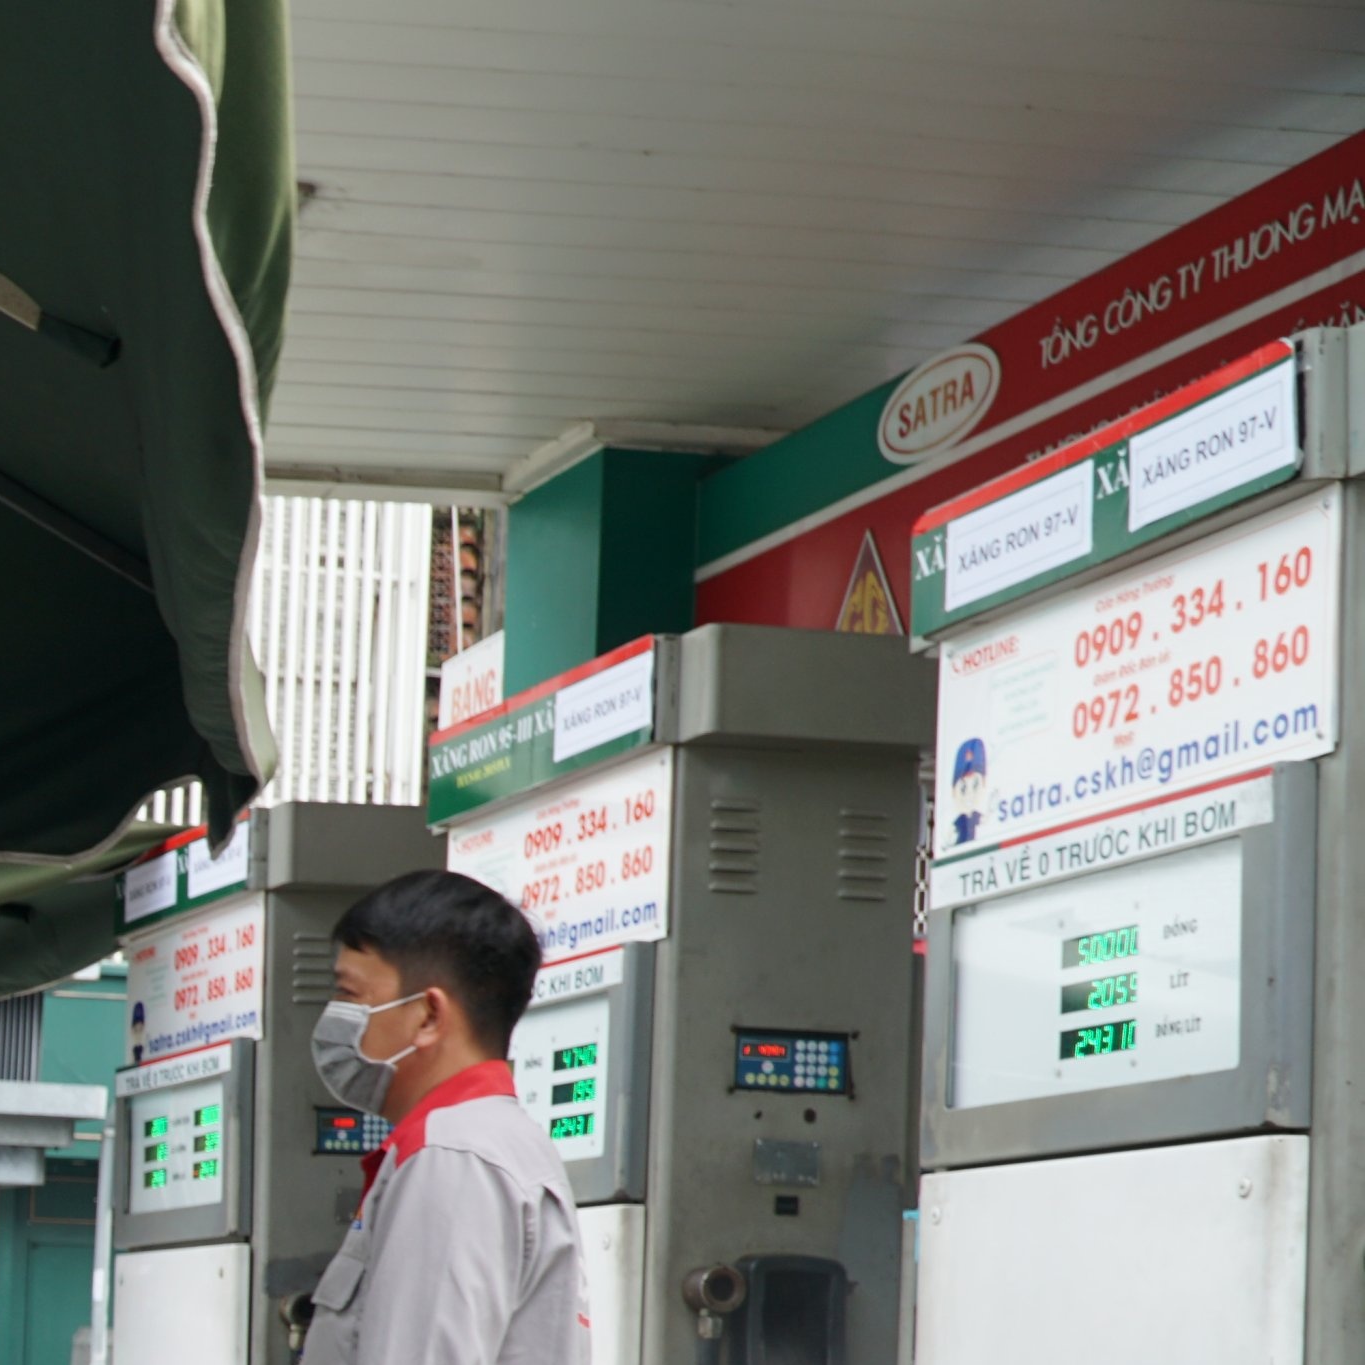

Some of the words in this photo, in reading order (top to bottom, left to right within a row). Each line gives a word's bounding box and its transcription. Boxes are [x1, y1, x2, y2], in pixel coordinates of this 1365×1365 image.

[1039, 316, 1098, 369] TỔNG
[1104, 276, 1172, 335] CÔNG
[1177, 257, 1205, 299] TY
[897, 371, 975, 440] SATRA
[1193, 430, 1235, 466] RON
[1238, 407, 1278, 444] 97-V
[1096, 450, 1130, 501] XĂ
[1005, 519, 1042, 552] RON
[1043, 503, 1079, 541] 97-V
[915, 535, 947, 582] XĂ
[1074, 610, 1143, 669] 0909
[1170, 580, 1225, 634] 334
[1256, 545, 1313, 603] 160
[592, 698, 617, 720] RON
[1072, 682, 1140, 739] 0972
[1168, 655, 1224, 708] 850
[1251, 624, 1310, 680] 860
[997, 703, 1319, 823] satra.cskh@gmail.com
[523, 822, 563, 859] 0909
[577, 805, 608, 841] 334
[624, 788, 655, 825] 160
[959, 863, 1000, 898] TRẢ
[1005, 844, 1032, 885] VỀ
[1056, 822, 1132, 874] TRƯỚC
[1137, 818, 1177, 853] KHI
[1184, 799, 1236, 836] BƠM
[521, 875, 560, 911] 0972
[575, 860, 606, 895] 850
[621, 845, 653, 881] 860
[174, 943, 199, 972] 0909
[207, 933, 226, 959] 334
[236, 923, 255, 948] 160
[174, 984, 199, 1012] 0972
[549, 970, 571, 994] KHI
[1169, 970, 1190, 990] LÍT
